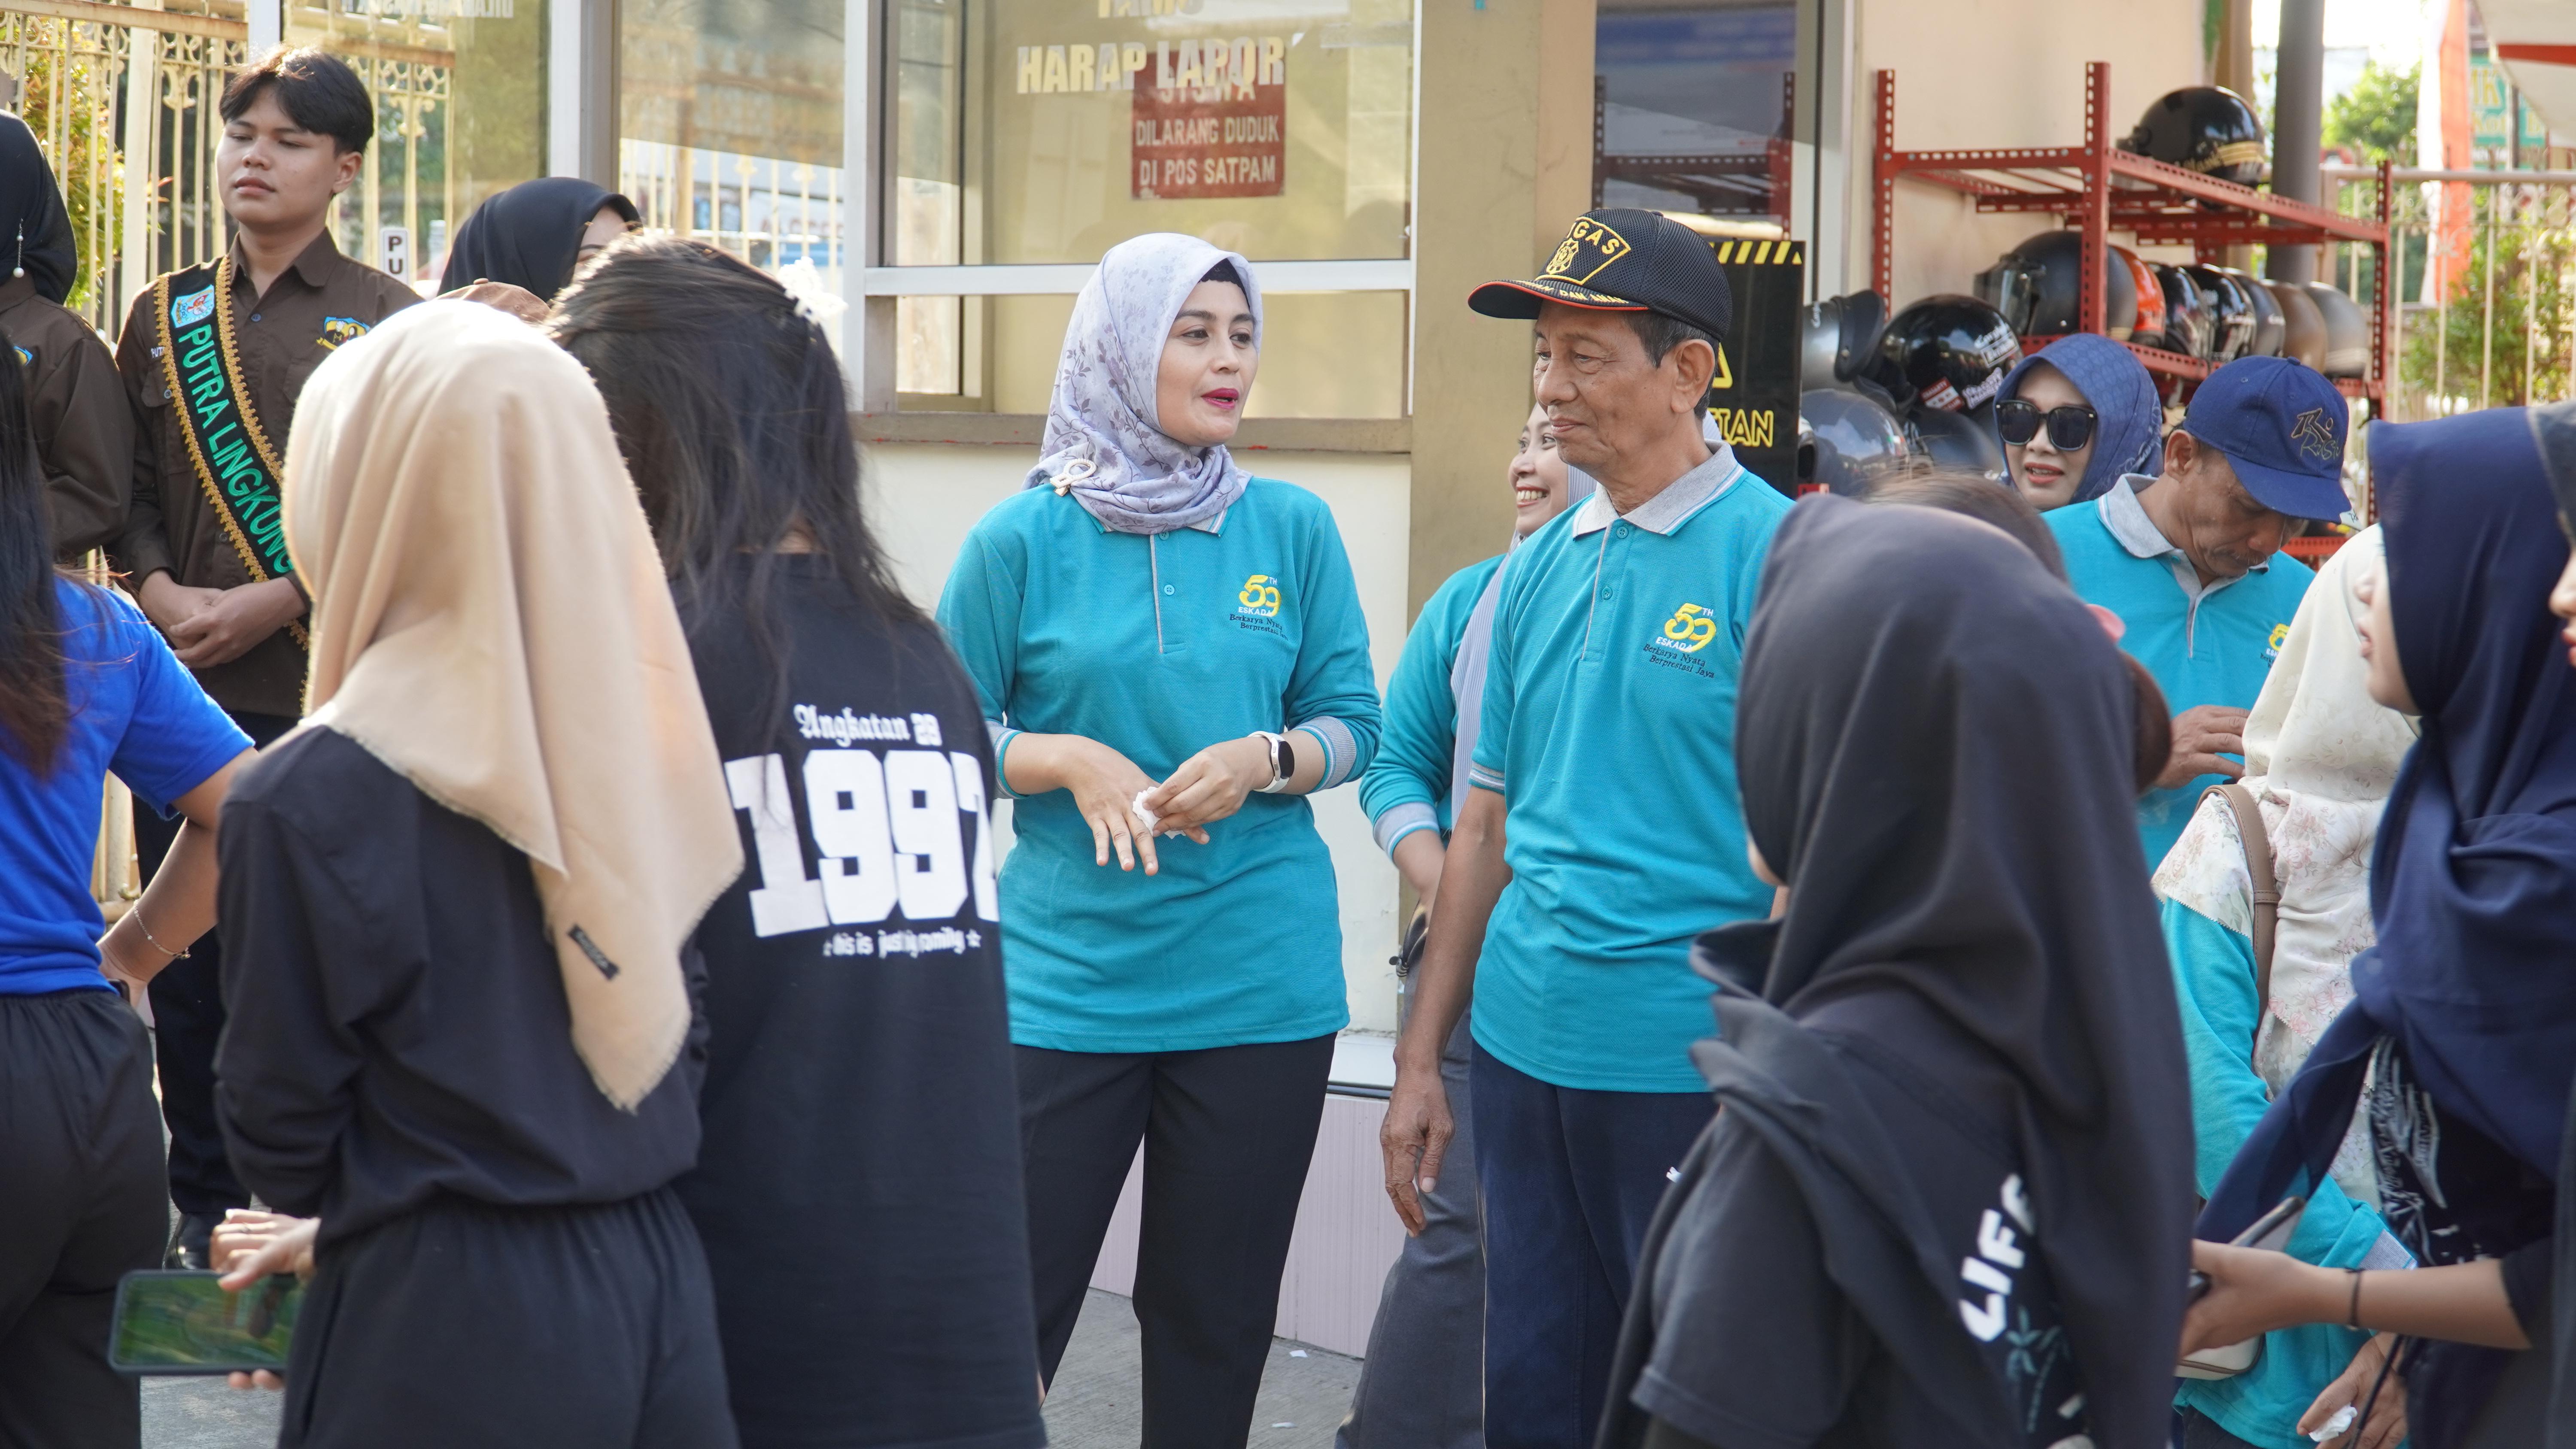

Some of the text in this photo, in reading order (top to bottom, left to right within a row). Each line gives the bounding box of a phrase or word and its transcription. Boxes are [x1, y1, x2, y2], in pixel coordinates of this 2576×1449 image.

[1017, 36, 1285, 94] HARAP LAPOR
[1136, 115, 1279, 146] DILARANG DUDUK
[1140, 155, 1276, 186] DI POS SATPAM
[1567, 221, 1620, 255] GAS
[1707, 407, 1774, 448] IAN
[178, 324, 294, 573] PUTRA LINGKUNG
[1238, 606, 1272, 617] ESKADA
[1239, 574, 1281, 617] 59 TH
[1230, 614, 1263, 624] Berkarya
[1665, 603, 1716, 653] 59 TH
[1643, 643, 1706, 667] Berkarya Nyata
[1656, 637, 1693, 652] ESKADA
[1649, 654, 1694, 672] Berprestasi
[793, 704, 911, 748] Angkatan
[724, 749, 1000, 938] 1997
